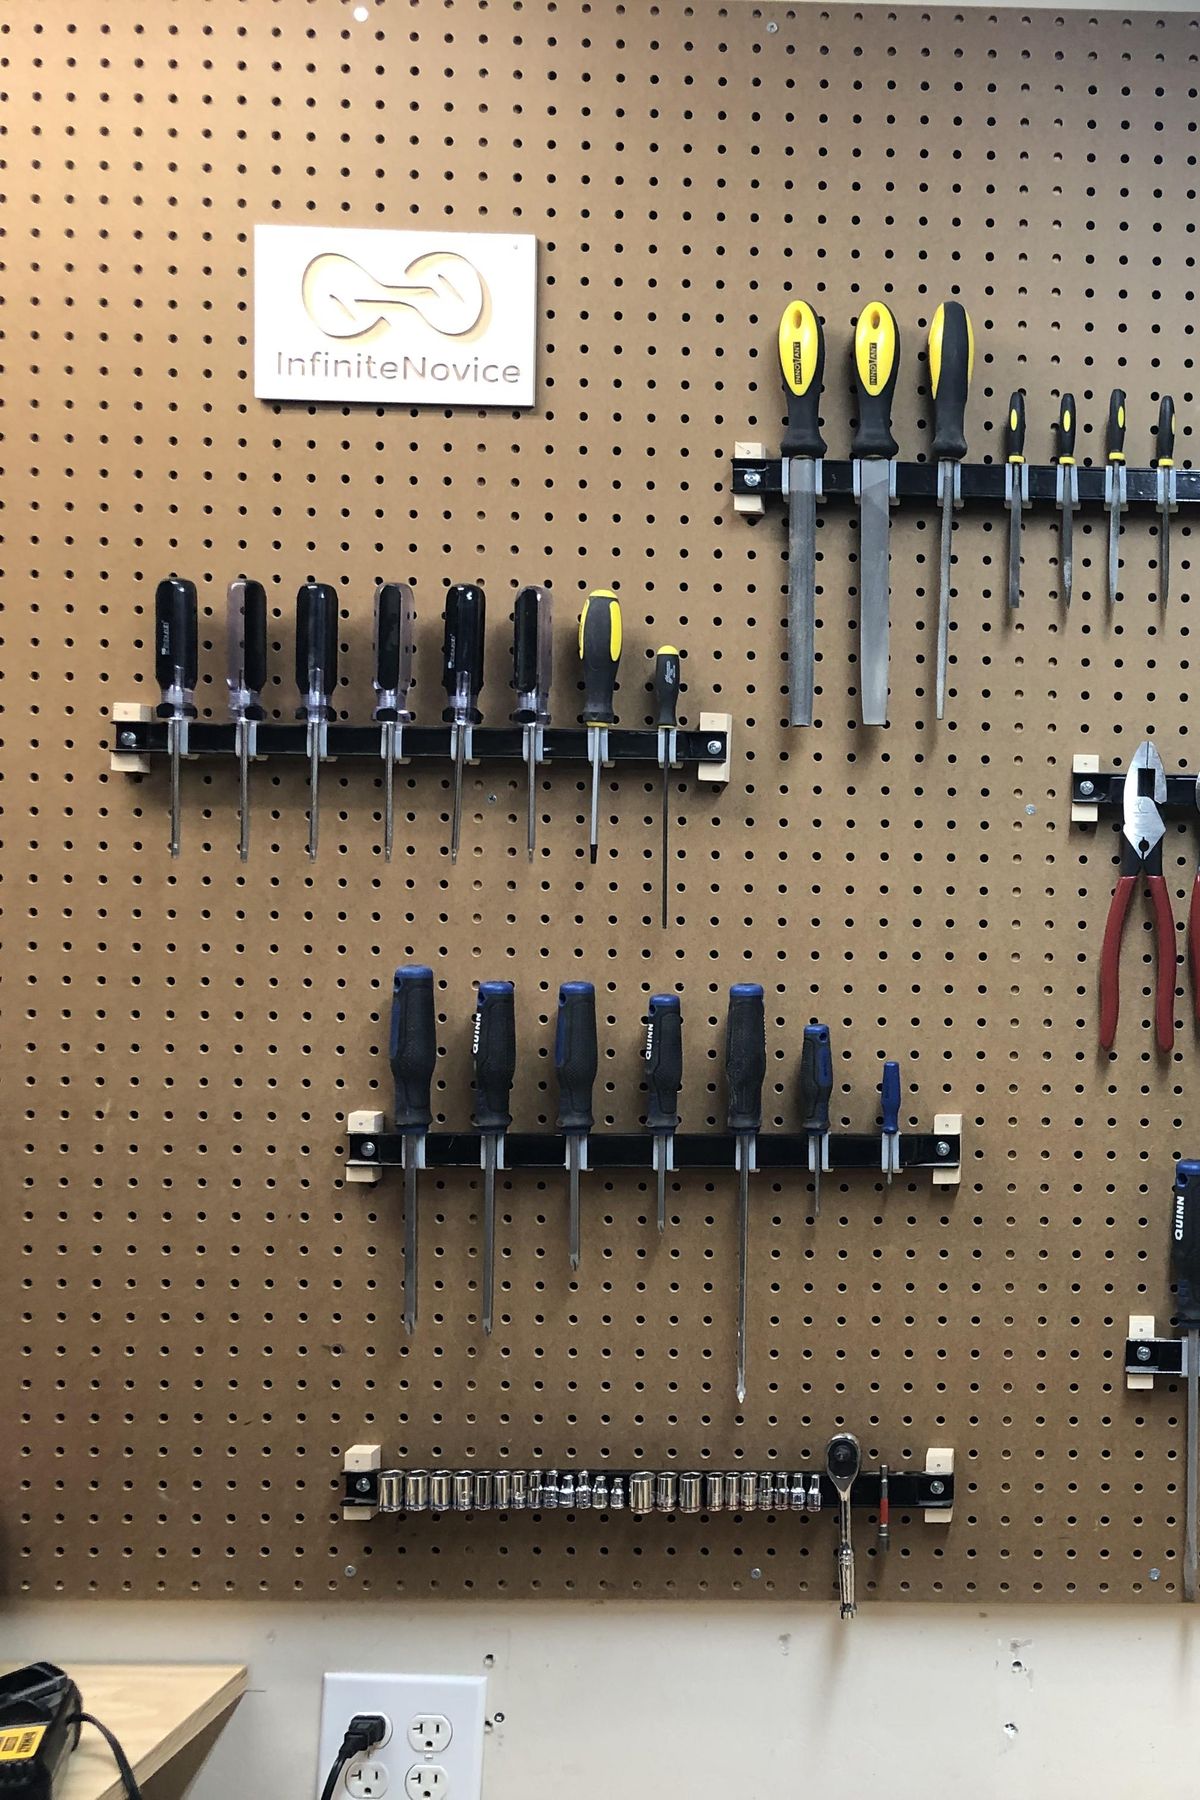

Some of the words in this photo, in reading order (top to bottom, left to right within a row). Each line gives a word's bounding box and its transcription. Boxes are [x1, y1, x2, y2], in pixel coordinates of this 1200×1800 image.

[277, 351, 521, 383] InfiniteNovice
[869, 343, 877, 385] INNOVANT
[472, 1013, 481, 1054] QUINN
[645, 1023, 654, 1060] QUINN
[1174, 1195, 1185, 1241] QUINN
